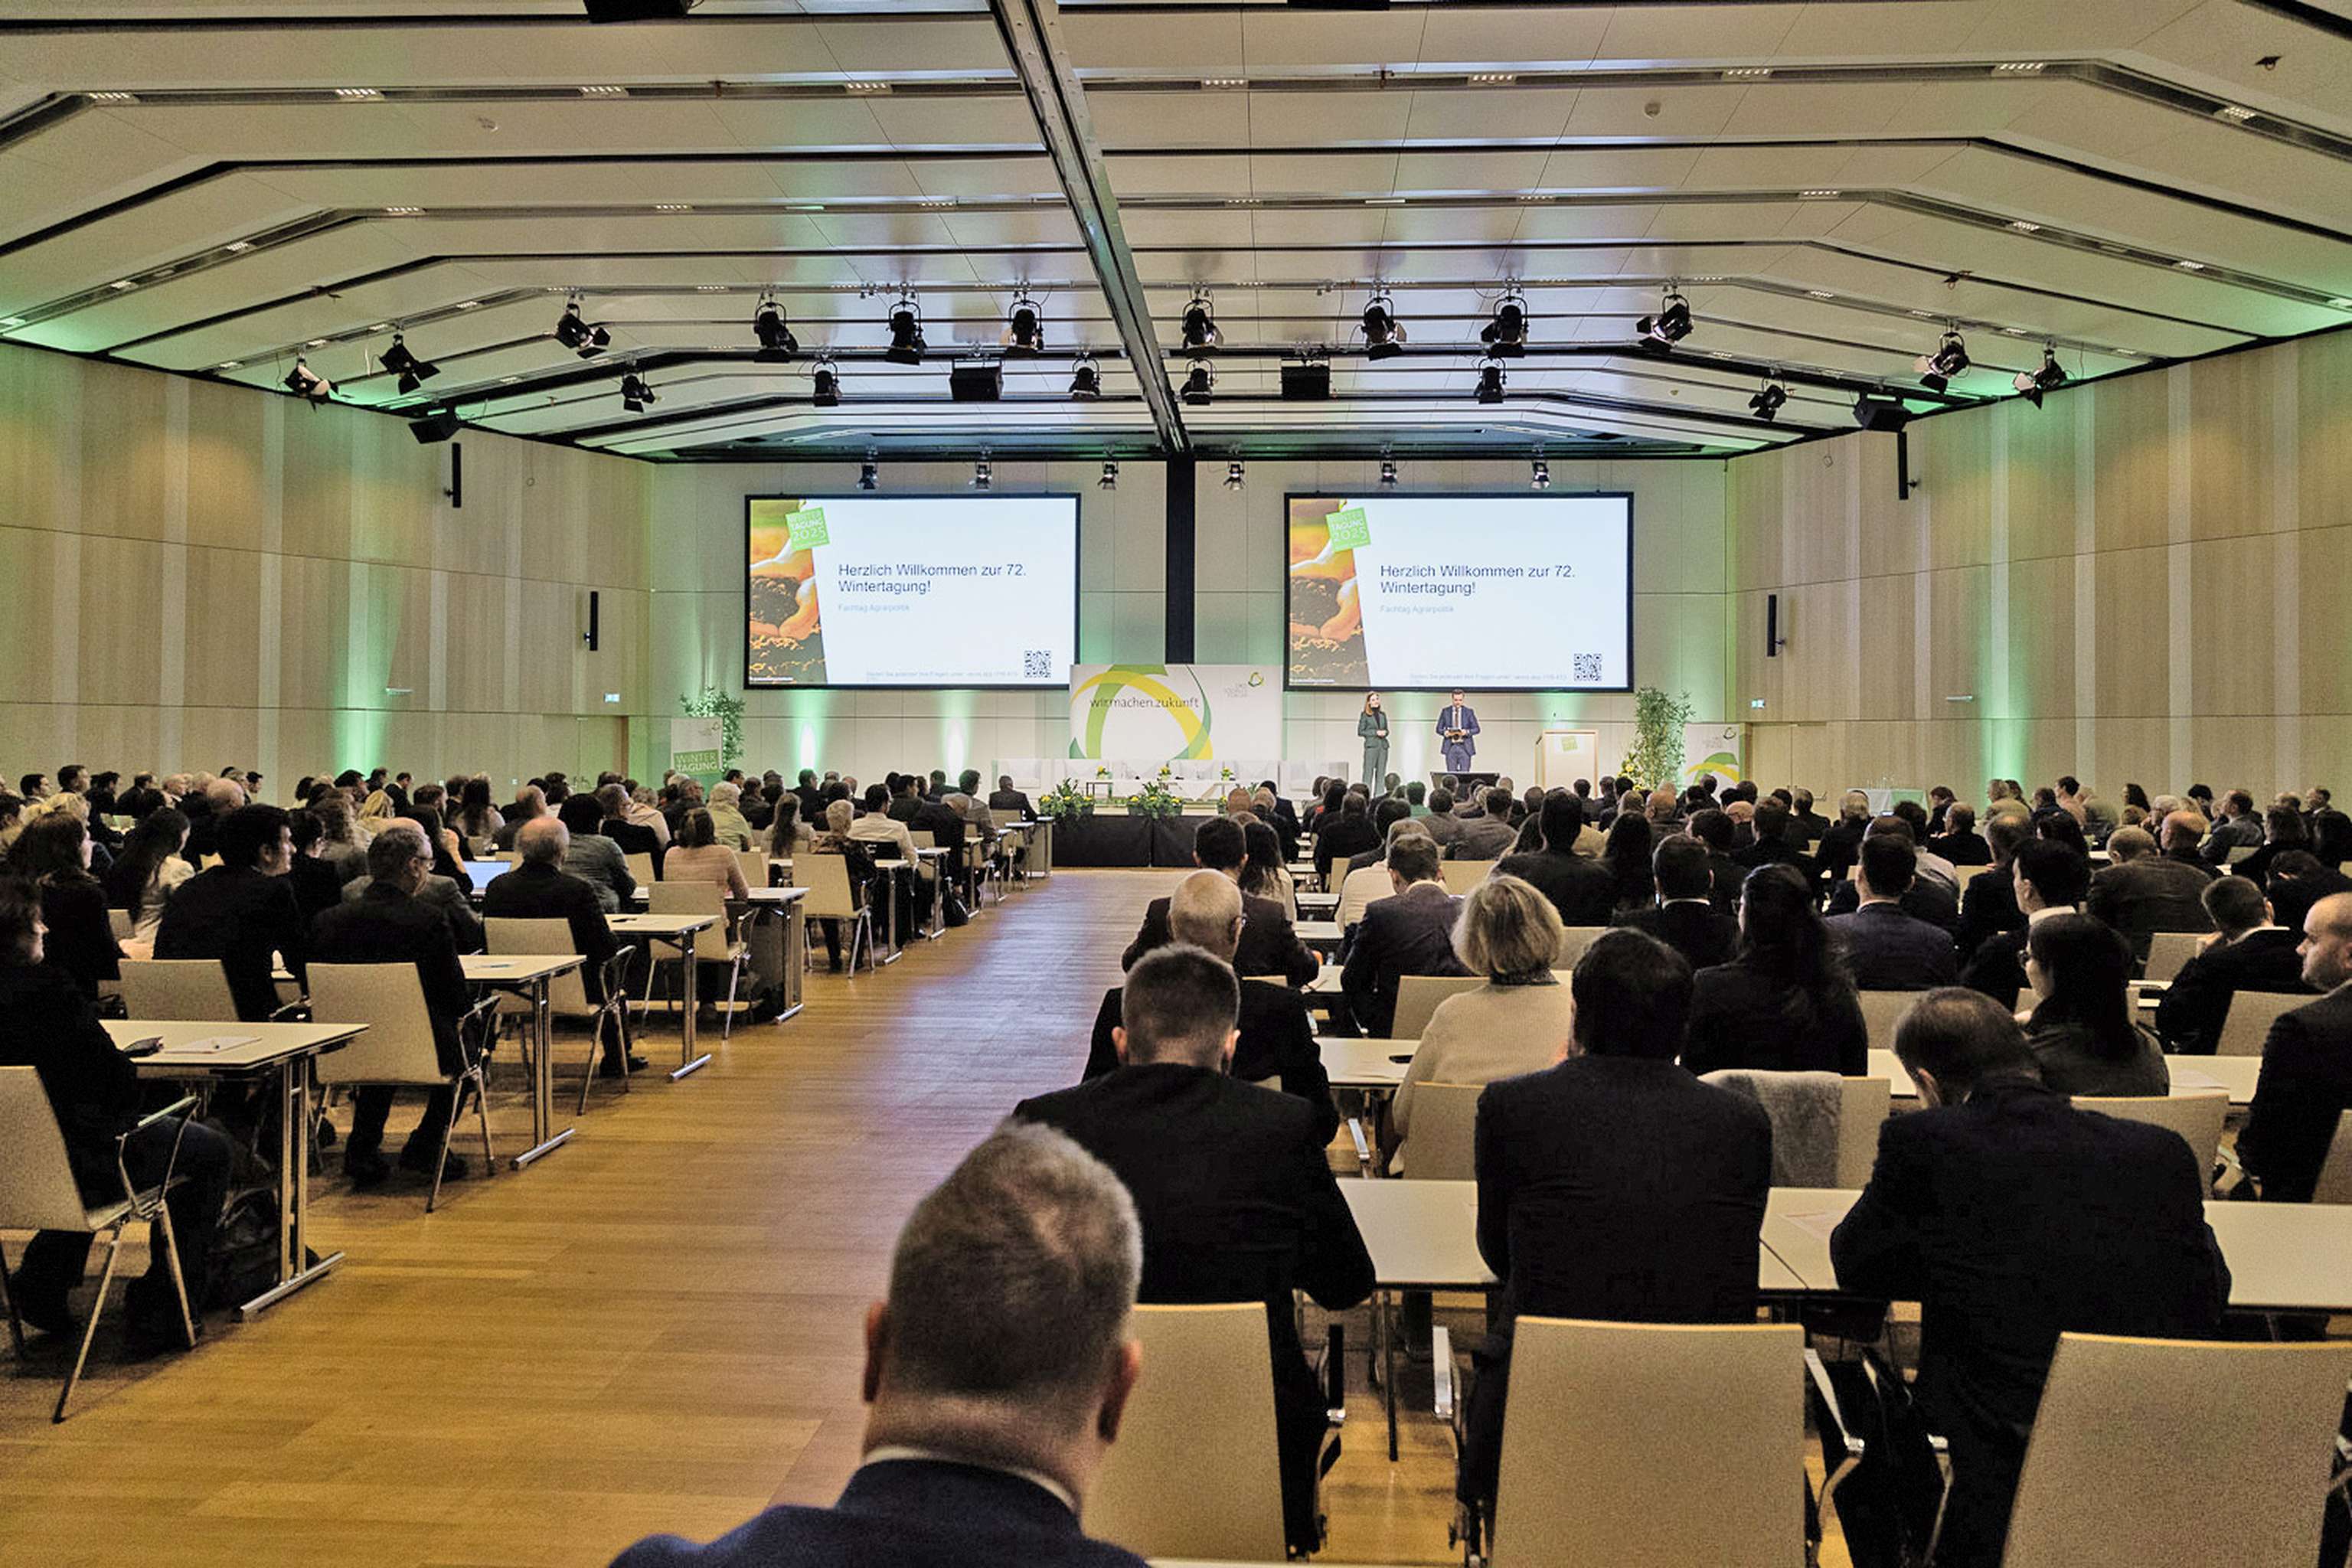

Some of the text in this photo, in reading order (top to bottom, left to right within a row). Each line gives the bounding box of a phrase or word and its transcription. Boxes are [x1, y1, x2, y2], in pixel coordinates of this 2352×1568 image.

[794, 526, 826, 541] 2025
[1333, 527, 1367, 541] 2025
[838, 564, 1027, 577] Herzlich Willkommen zur 72.
[1380, 565, 1576, 578] Herzlich Willkommen zur 72.
[838, 580, 931, 595] Wintertagung!
[1380, 581, 1476, 597] Wintertagung!
[676, 753, 717, 763] WINTER
[676, 761, 717, 773] TAGUNG
